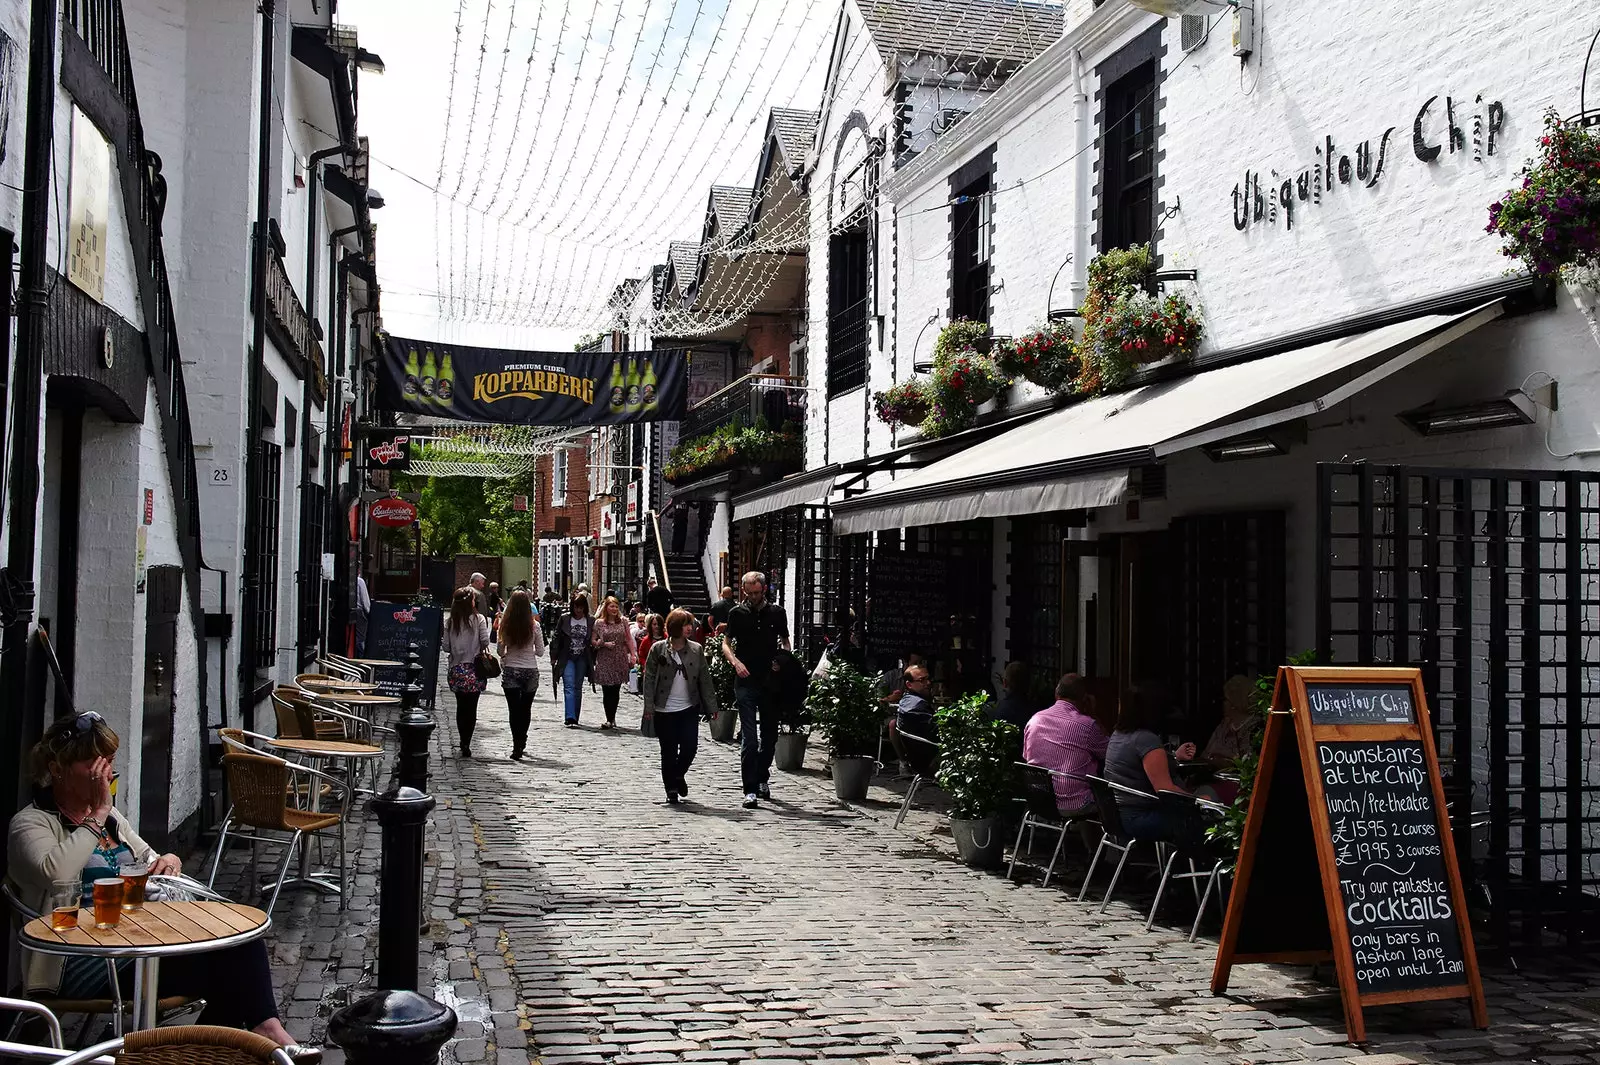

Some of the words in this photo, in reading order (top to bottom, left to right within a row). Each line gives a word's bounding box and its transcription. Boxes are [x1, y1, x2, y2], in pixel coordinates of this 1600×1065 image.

[1230, 126, 1396, 231] Ubiquitous
[1412, 94, 1505, 163] Chip
[504, 363, 542, 371] PREMIUM
[543, 364, 566, 373] CIDER
[472, 370, 594, 405] KOPPARBERG
[214, 469, 228, 481] 23
[1311, 690, 1377, 716] Ubiquitous
[1380, 693, 1409, 716] Chip
[1319, 744, 1423, 765] Downstairs
[1324, 765, 1349, 785] at
[1351, 766, 1382, 785] the
[1391, 823, 1401, 836] 2
[1402, 823, 1436, 836] courses
[1395, 844, 1405, 858] 3
[1406, 845, 1441, 857] courses
[1340, 879, 1366, 900] Try
[1369, 880, 1388, 894] our
[1393, 877, 1447, 897] fantastic
[1351, 933, 1381, 951] Only
[1386, 932, 1421, 945] bars
[1427, 930, 1440, 943] in
[1355, 950, 1406, 965] Ashton
[1412, 946, 1445, 961] lane
[1356, 966, 1391, 984] open
[1397, 962, 1433, 977] until
[1436, 958, 1465, 975] 1am
